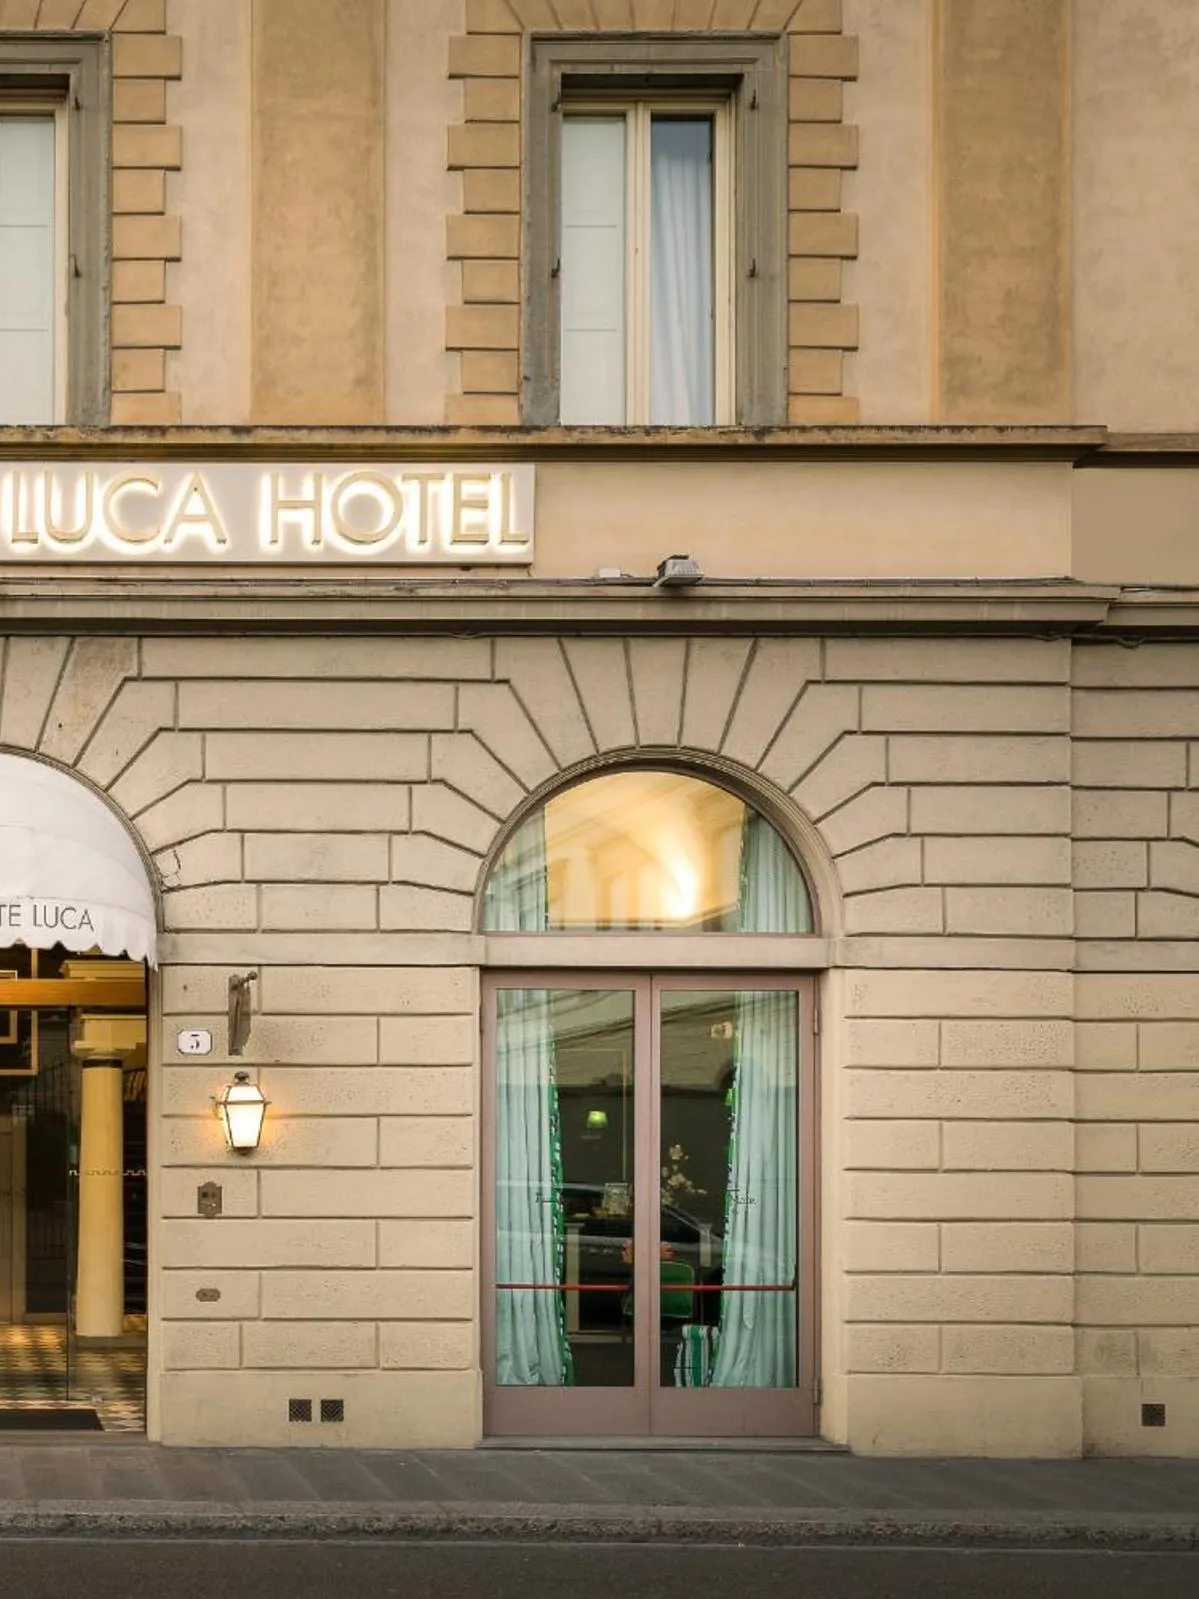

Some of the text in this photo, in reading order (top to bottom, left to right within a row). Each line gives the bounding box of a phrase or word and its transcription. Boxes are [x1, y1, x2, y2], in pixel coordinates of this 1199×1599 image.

[9, 470, 228, 546] LUCA
[268, 470, 530, 547] HOTEL
[32, 904, 95, 933] LUCA
